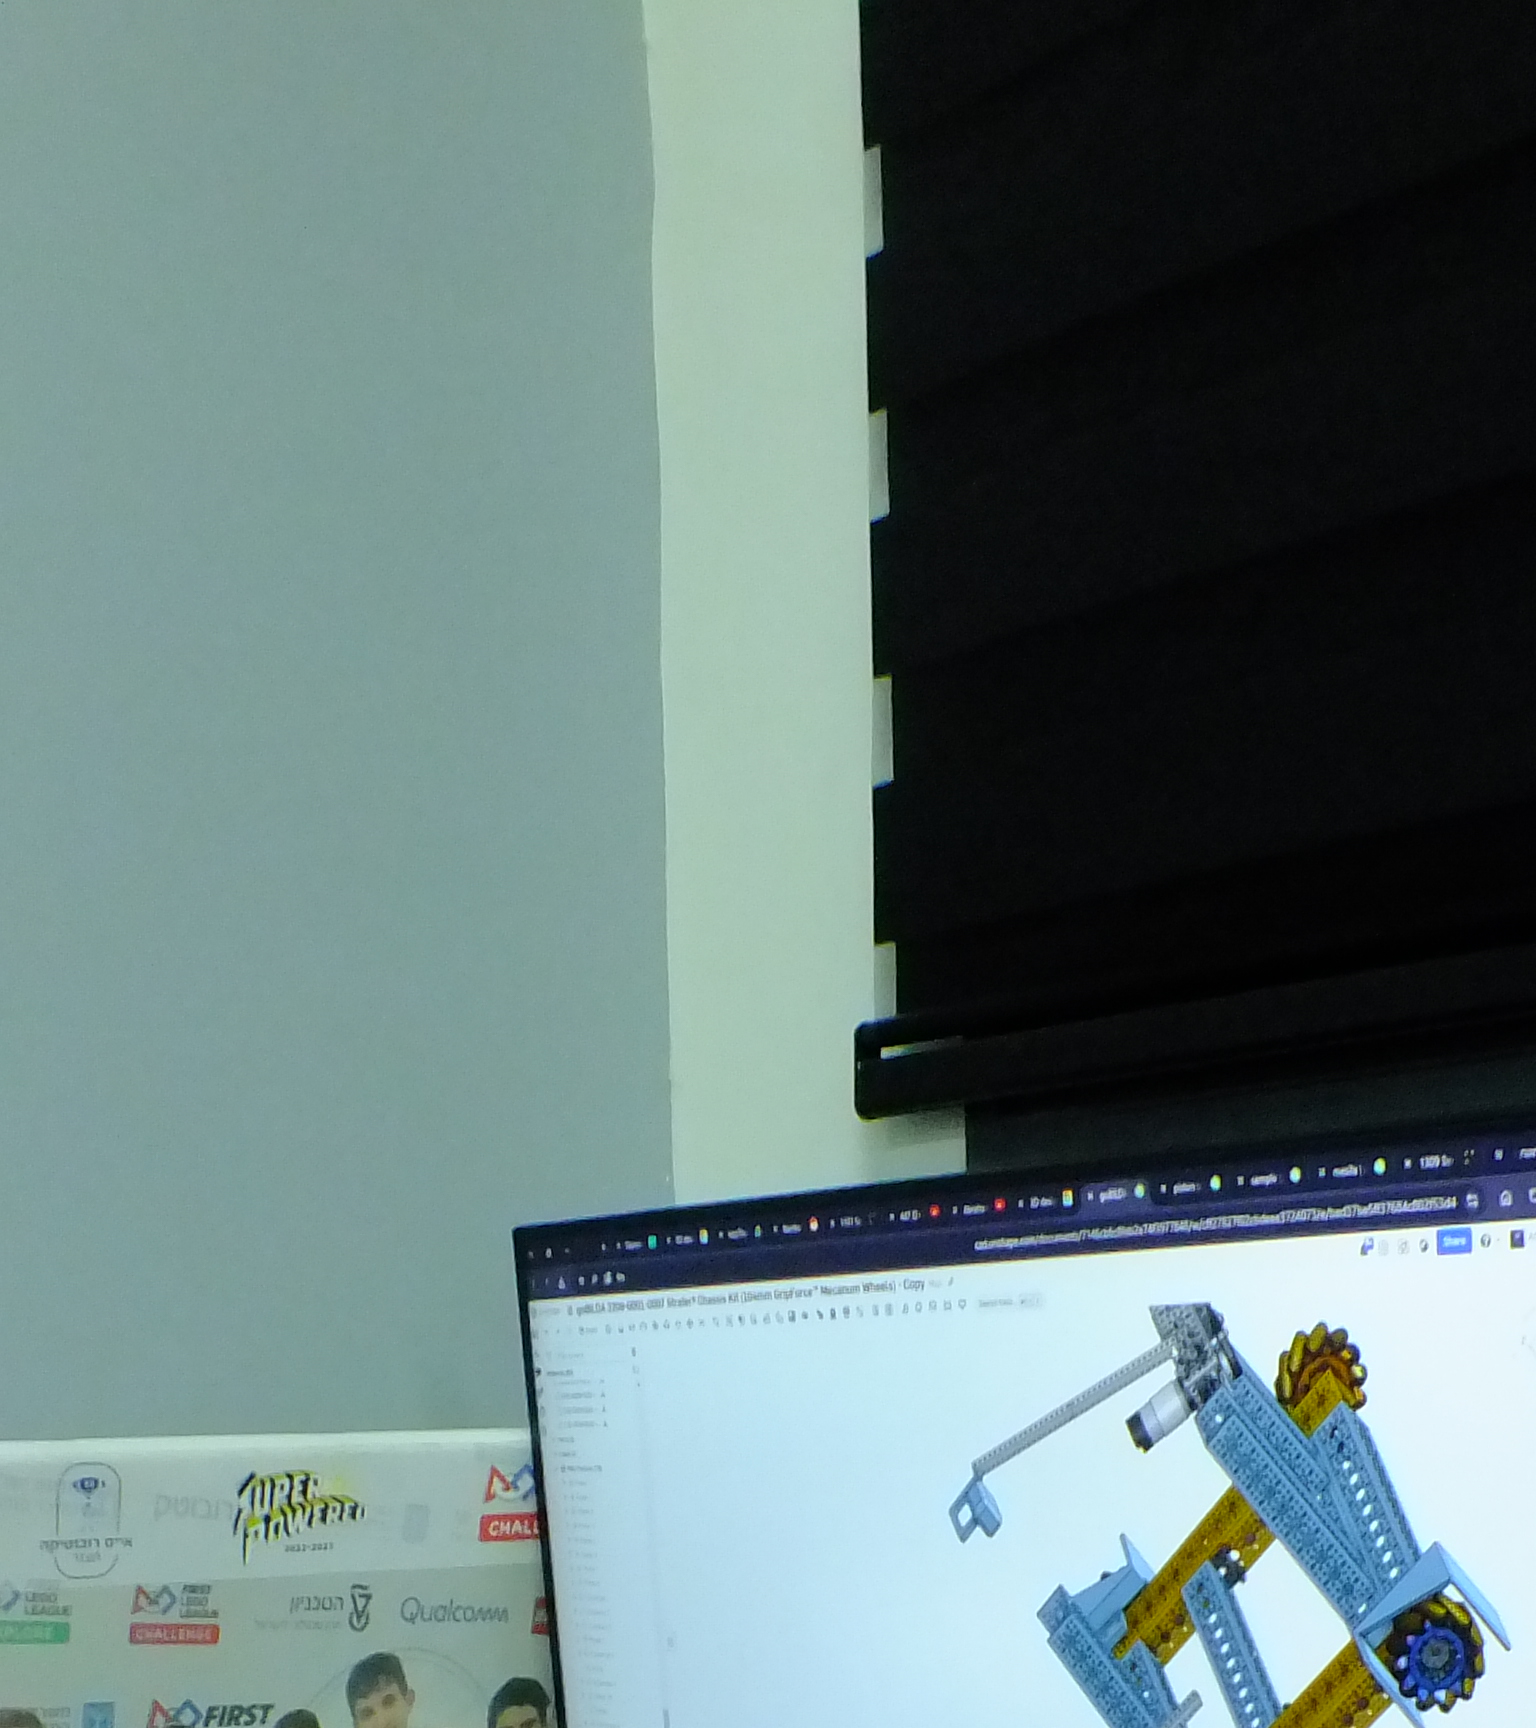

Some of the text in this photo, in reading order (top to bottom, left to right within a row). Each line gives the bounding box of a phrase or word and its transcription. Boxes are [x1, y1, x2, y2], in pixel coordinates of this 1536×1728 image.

[903, 1278, 925, 1292] Copy
[488, 1518, 540, 1537] CHALL
[400, 1595, 509, 1625] Qualcomm
[203, 1703, 276, 1728] FIRST
